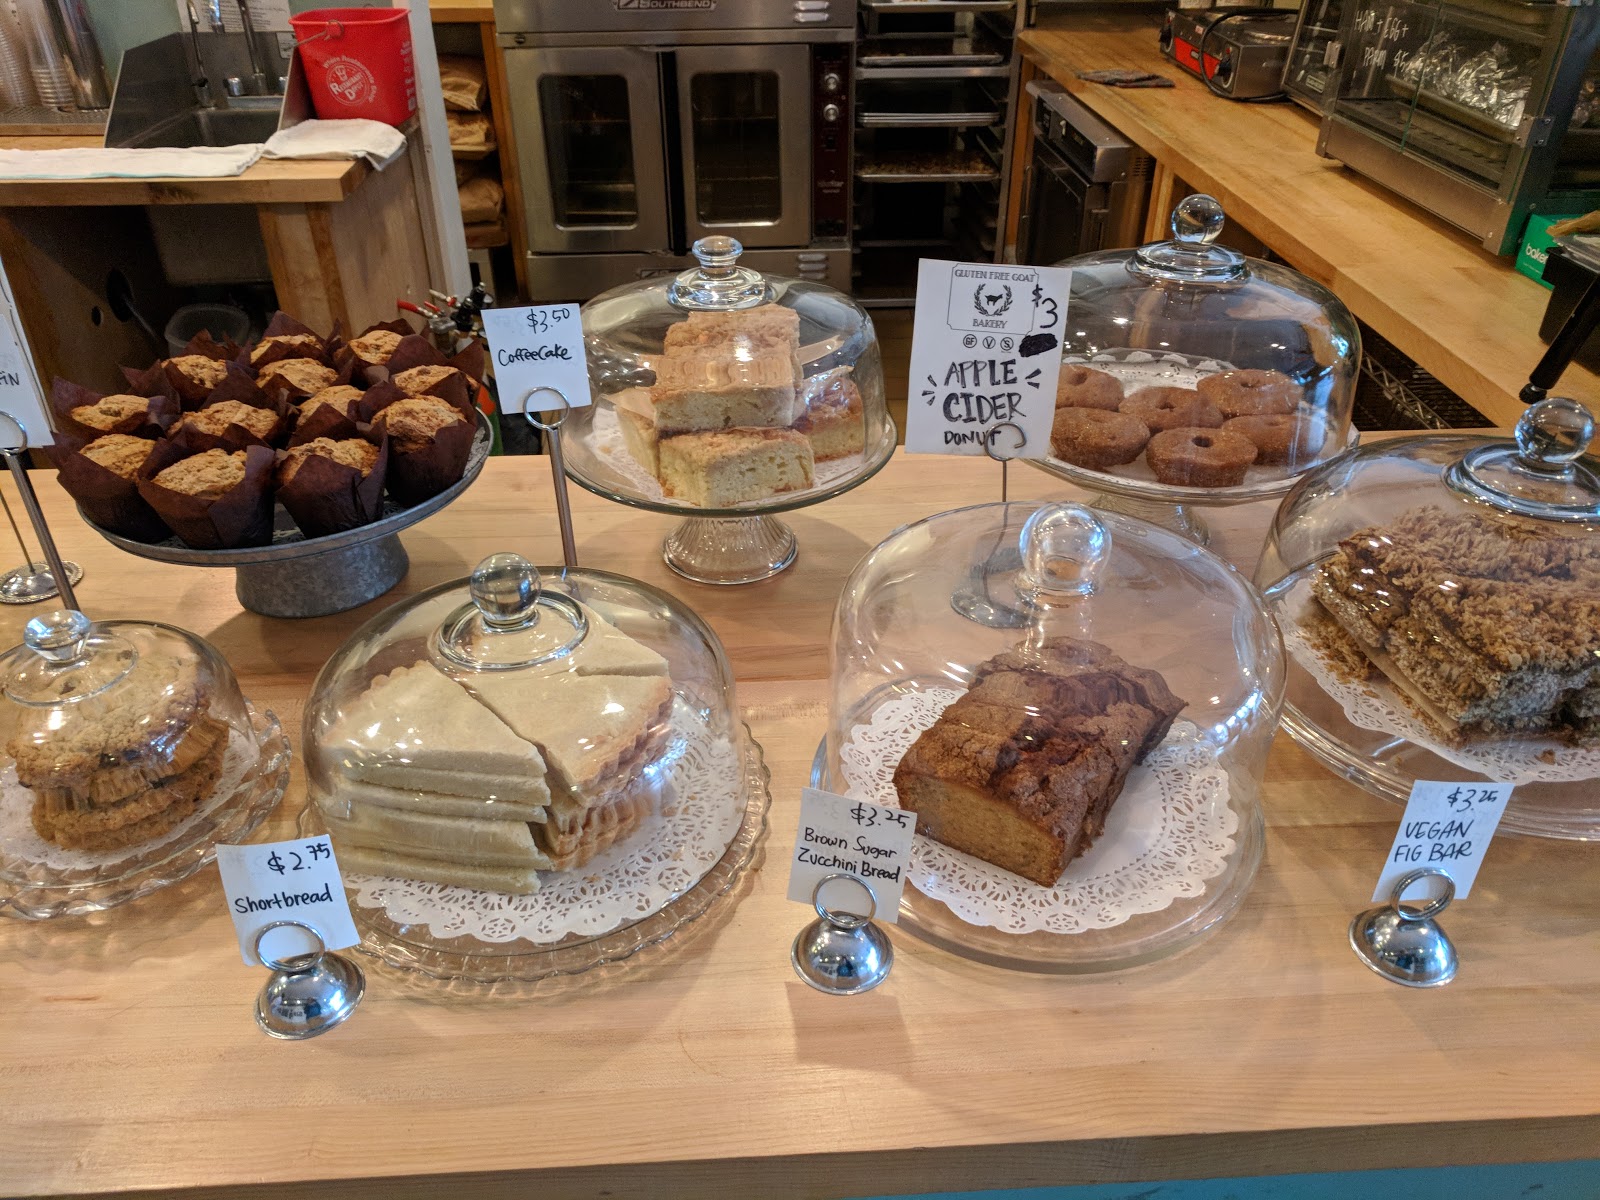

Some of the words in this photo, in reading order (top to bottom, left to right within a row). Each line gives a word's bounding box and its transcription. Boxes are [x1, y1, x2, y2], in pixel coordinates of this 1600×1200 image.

[638, 0, 711, 9] SOUTHBEND
[954, 269, 988, 280] GLUTEN
[989, 271, 1010, 281] FREE
[1011, 273, 1036, 283] GOAT
[1031, 283, 1059, 329] $3
[972, 318, 1008, 329] BAKERY
[944, 358, 1018, 389] APPLE
[942, 391, 1027, 425] CIDER
[944, 430, 1001, 446] DONUT
[804, 826, 848, 849] Brown
[852, 835, 898, 859] Sugar
[1405, 819, 1475, 841] VEGAN
[797, 846, 858, 874] Zucchini
[860, 860, 901, 883] Bread
[1393, 844, 1423, 863] FIG
[1428, 840, 1473, 862] BAR
[234, 882, 334, 914] Shortbread
